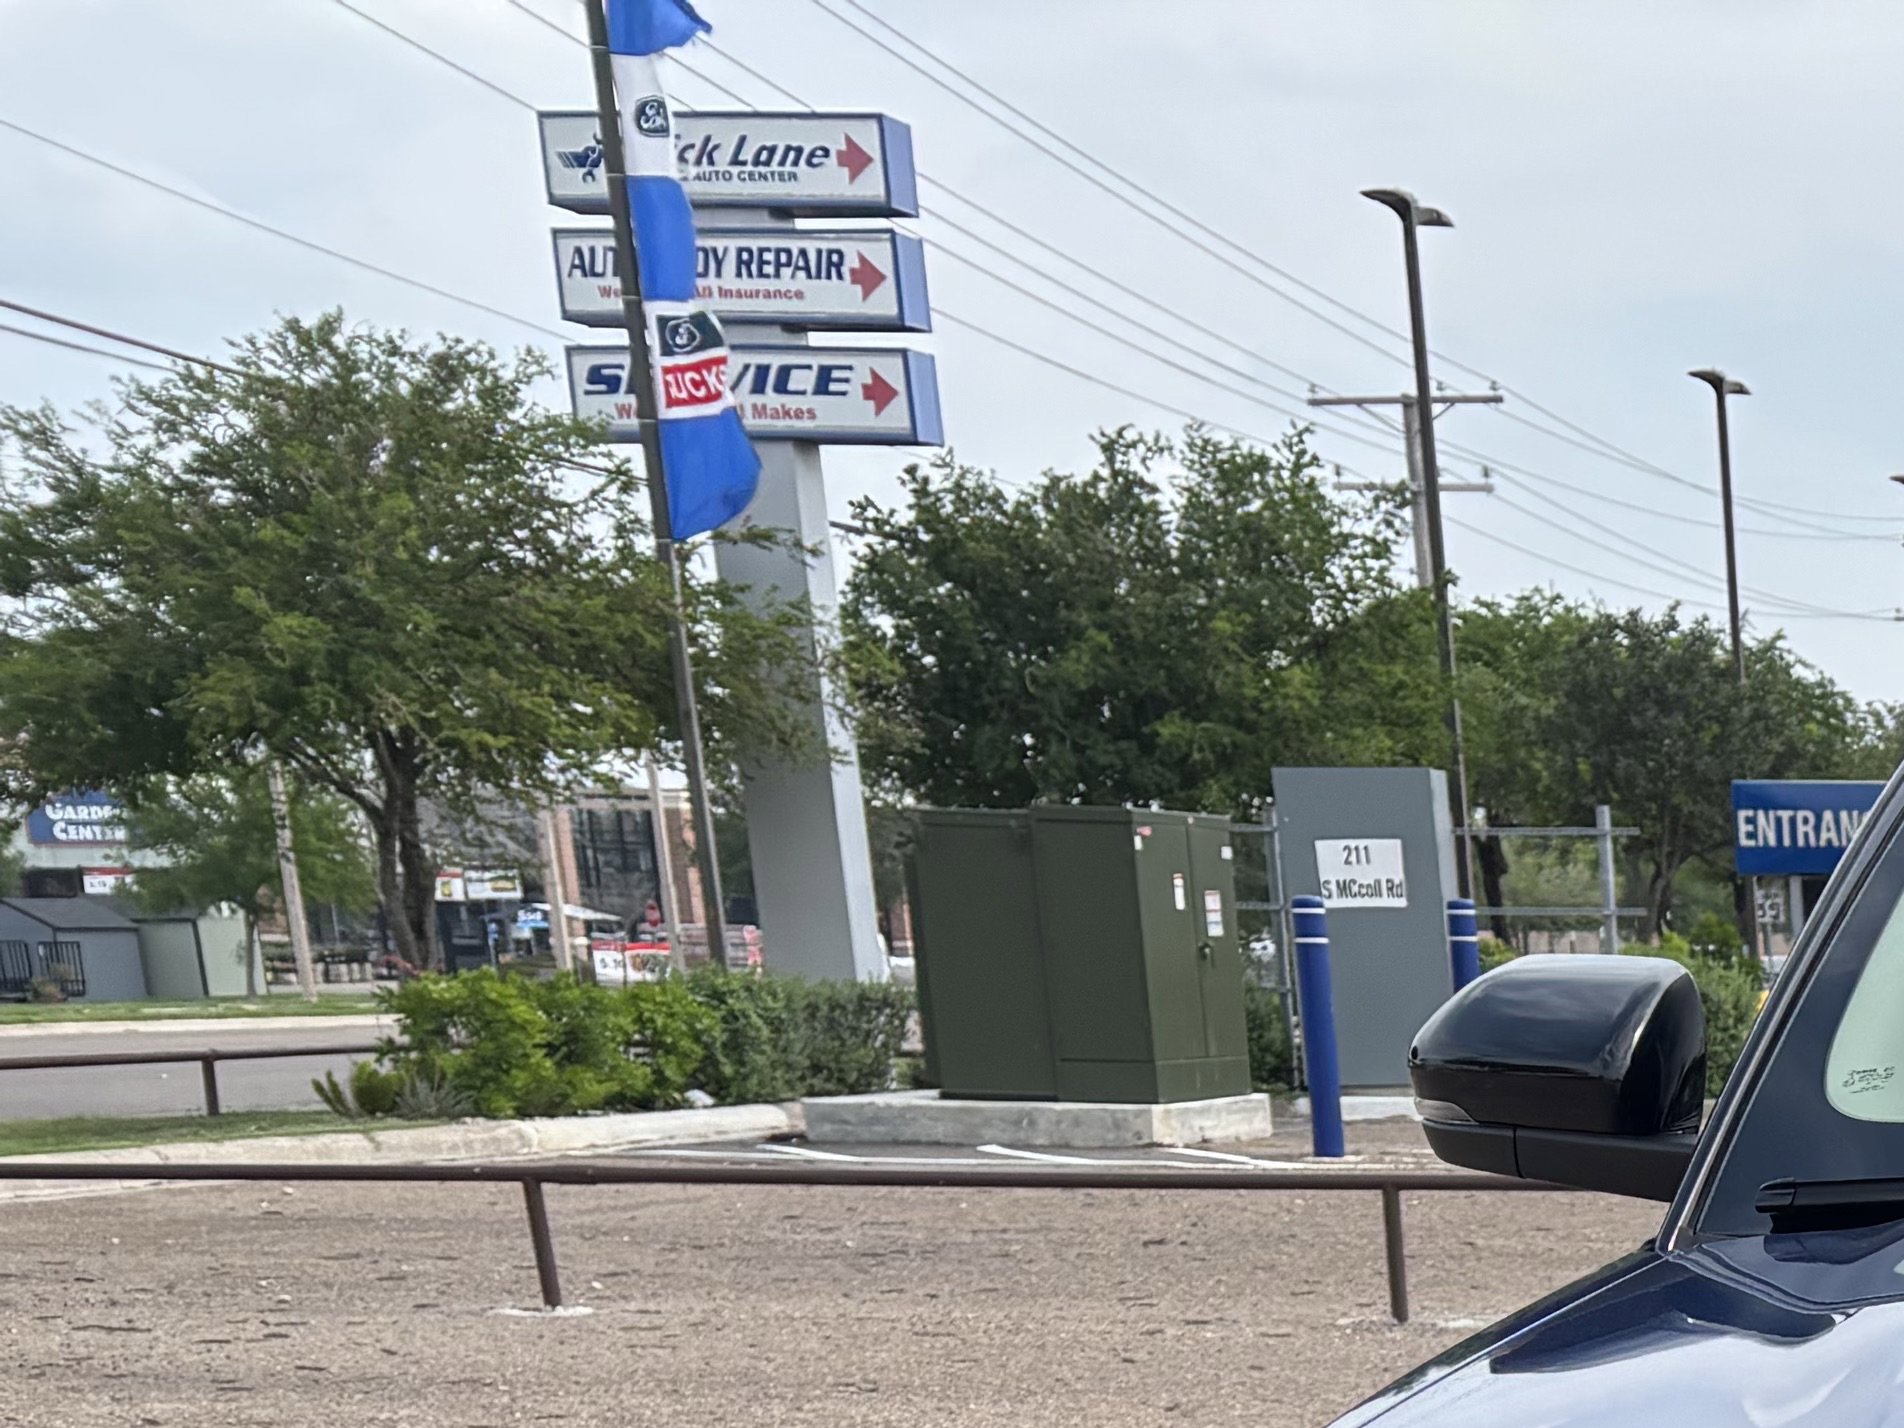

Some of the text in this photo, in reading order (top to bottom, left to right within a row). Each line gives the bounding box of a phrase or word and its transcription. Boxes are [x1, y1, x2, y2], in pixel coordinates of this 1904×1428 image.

[727, 134, 831, 168] Lane
[693, 170, 733, 183] AUTO
[737, 170, 799, 183] CENTER
[735, 247, 845, 281] REPAIR
[718, 286, 805, 301] Insurance
[751, 404, 818, 421] Makes
[1737, 809, 1871, 848] ENTRAN
[1342, 845, 1371, 866] 211
[1321, 879, 1333, 899] S
[1386, 878, 1404, 898] Rd
